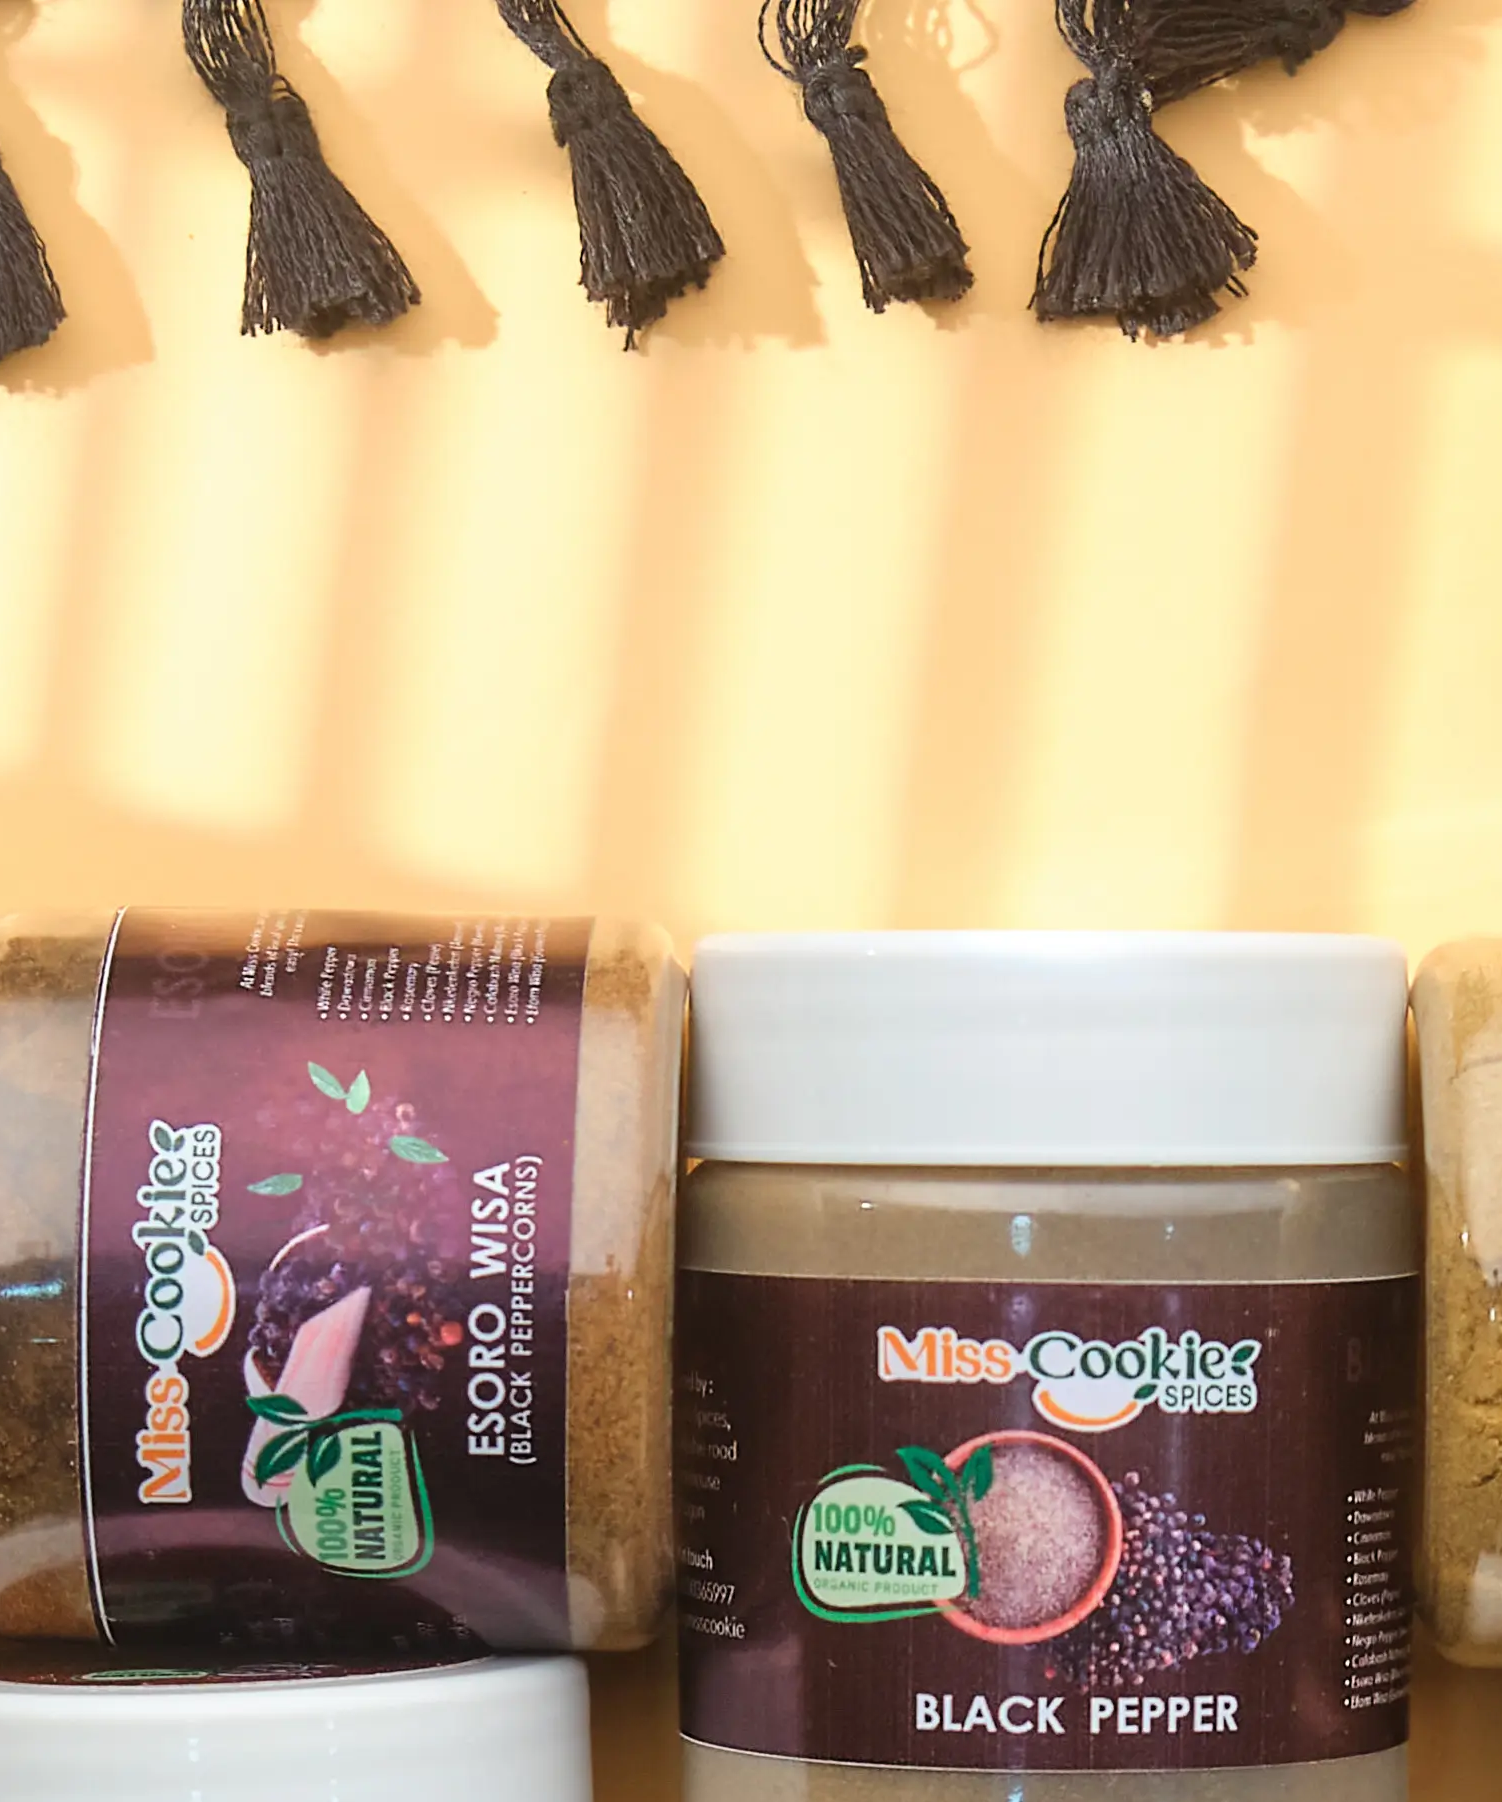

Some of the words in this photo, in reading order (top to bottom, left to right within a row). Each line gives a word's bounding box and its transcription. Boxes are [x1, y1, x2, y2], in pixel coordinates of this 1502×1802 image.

[191, 1129, 217, 1223] SPICES
[471, 1163, 511, 1278] WISA
[138, 1160, 188, 1359] Cookie
[511, 1154, 543, 1356] PEPPERCORNS)
[467, 1304, 507, 1456] ESORO
[884, 1331, 1011, 1378] Miss
[1029, 1331, 1225, 1381] Cookie
[1165, 1384, 1252, 1407] SPICES
[143, 1377, 188, 1498] Miss
[508, 1372, 535, 1464] (BLACK
[316, 1488, 348, 1560] 100%
[351, 1431, 385, 1560] NATURAL
[813, 1503, 895, 1537] 100%
[813, 1577, 869, 1594] ORGANIC
[875, 1582, 938, 1596] PRODUCT
[814, 1540, 956, 1578] NATURAL
[915, 1693, 1065, 1734] BLACK
[1090, 1695, 1238, 1734] PEPPER
